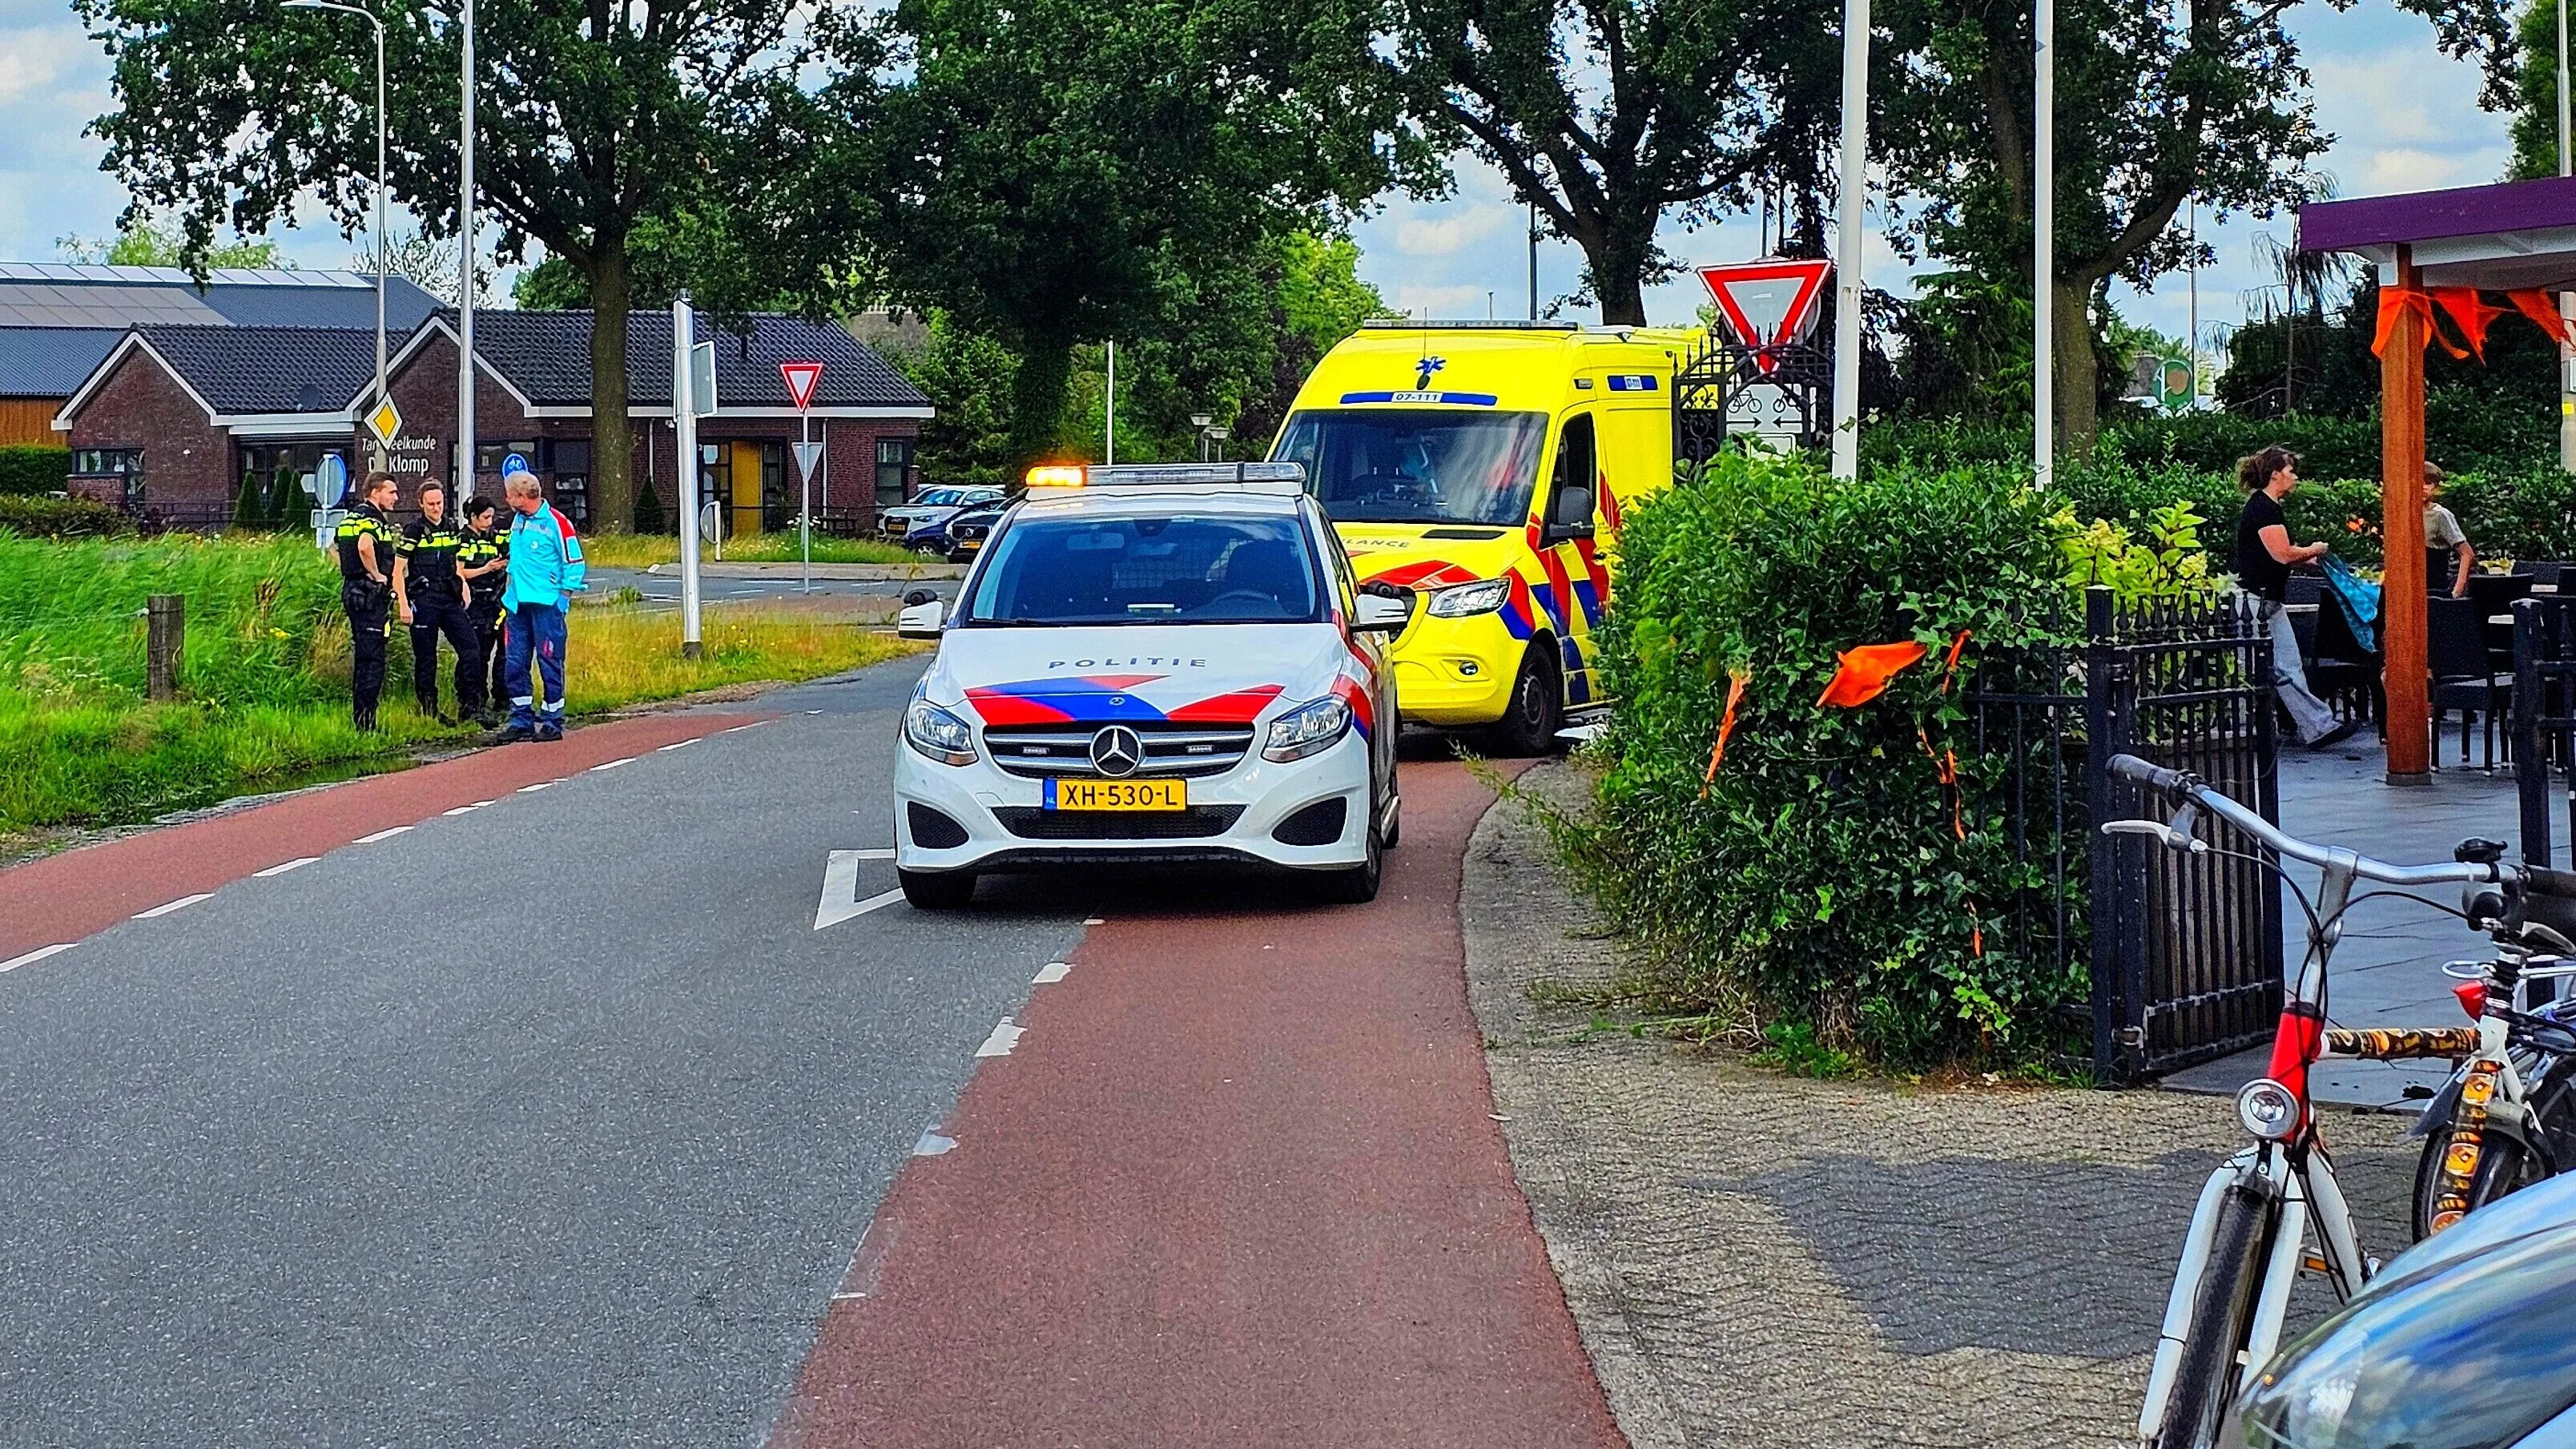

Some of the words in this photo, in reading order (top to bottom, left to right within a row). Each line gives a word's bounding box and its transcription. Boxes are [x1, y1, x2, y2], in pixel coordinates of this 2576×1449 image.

[1395, 393, 1439, 401] 07-111
[362, 435, 437, 452] Taneelkunde
[388, 453, 429, 477] Klomp
[1342, 538, 1410, 549] LANCE
[1049, 657, 1206, 670] POLITIE
[1065, 784, 1177, 807] XH-530-L
